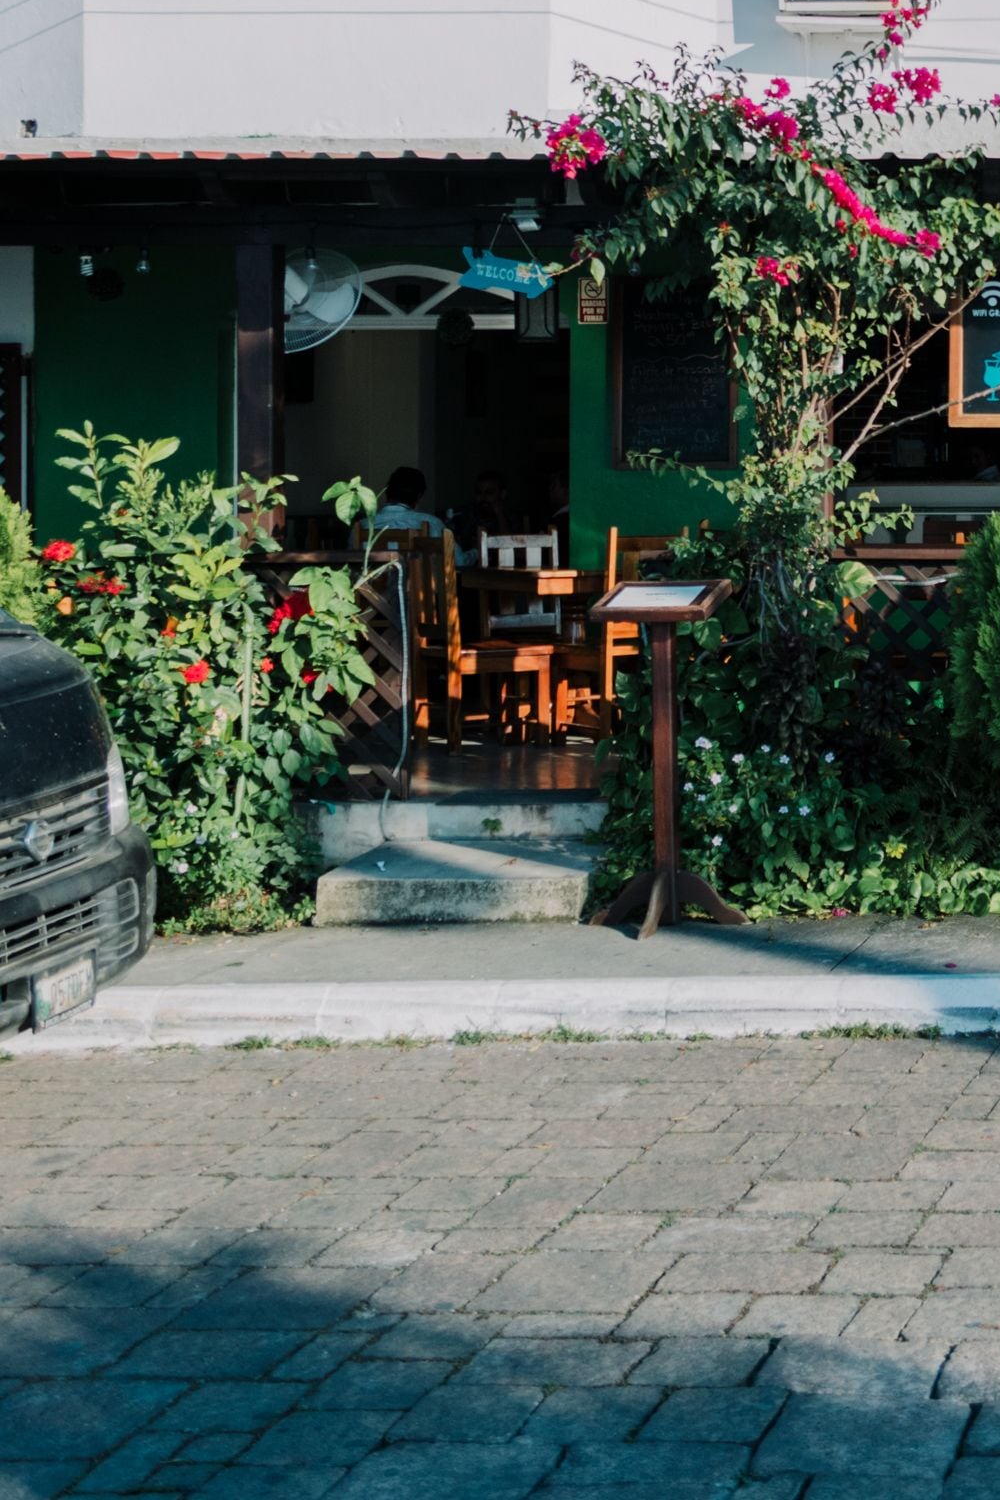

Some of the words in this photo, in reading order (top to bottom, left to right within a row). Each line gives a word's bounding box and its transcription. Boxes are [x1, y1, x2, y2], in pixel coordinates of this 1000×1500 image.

[582, 307, 595, 315] POR
[596, 307, 605, 315] NO
[972, 309, 987, 317] WIFI
